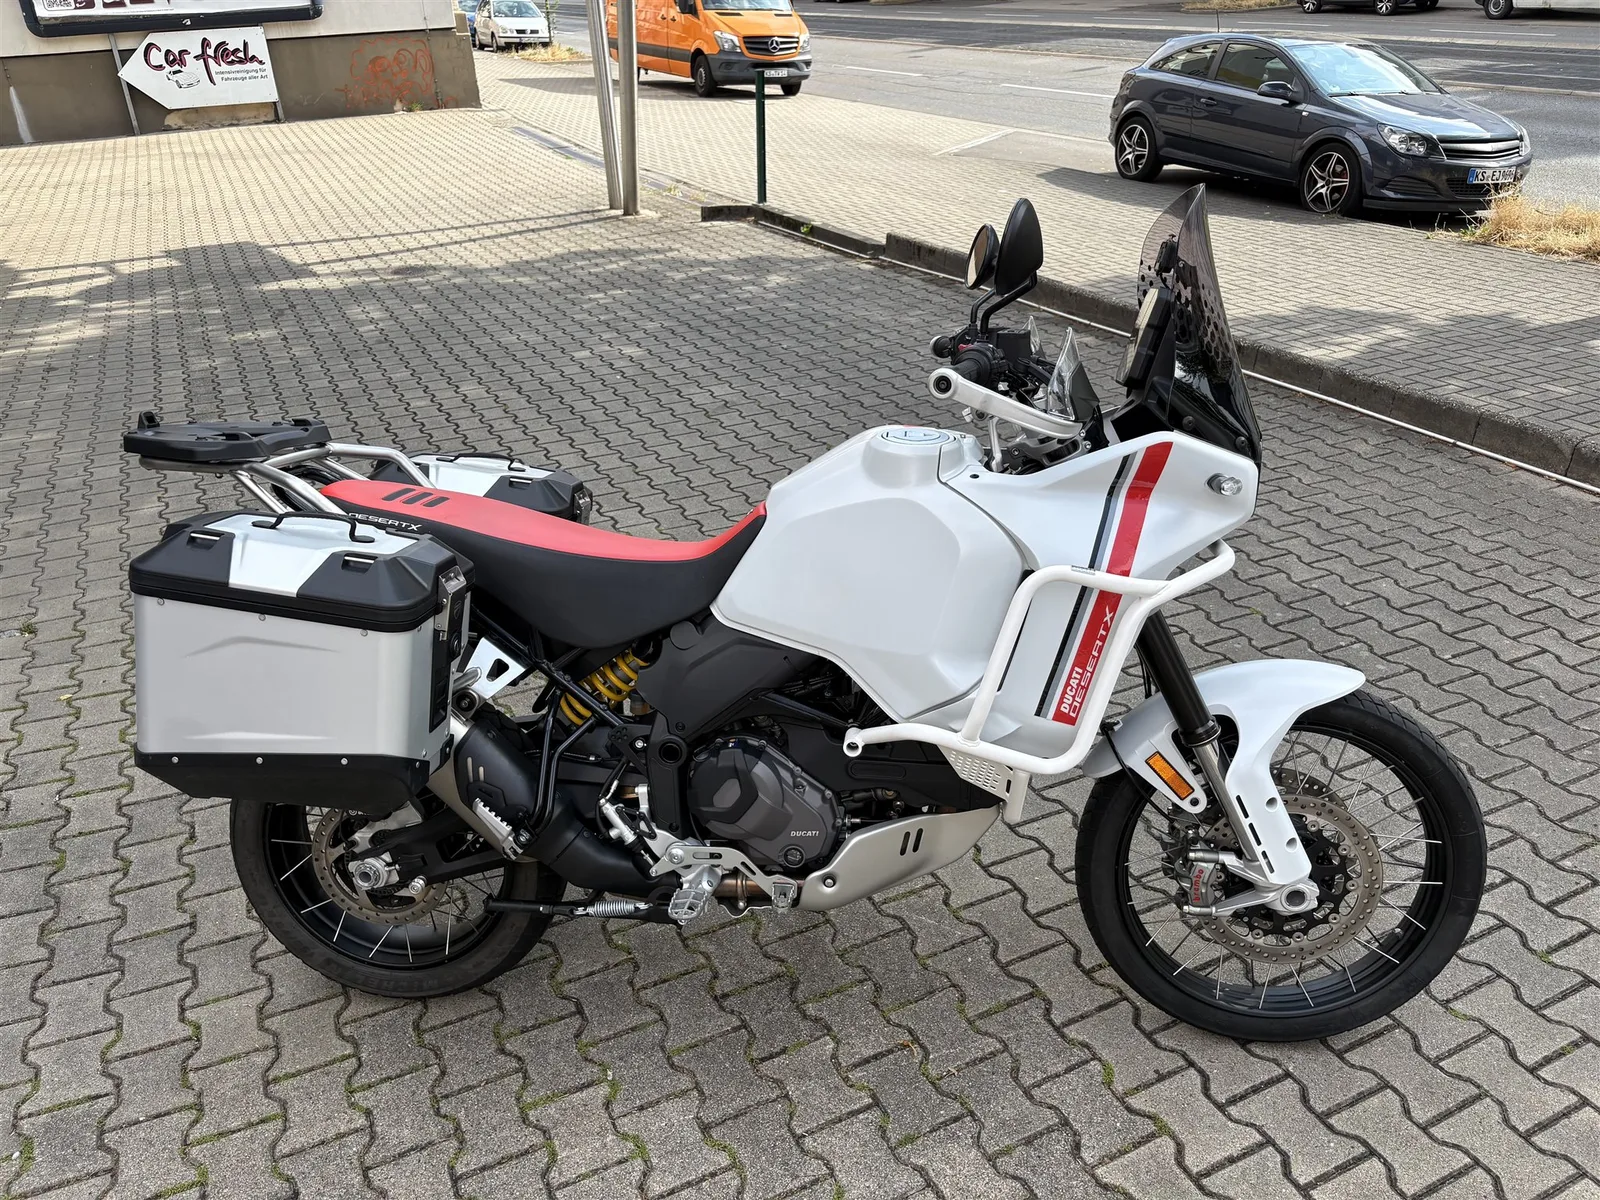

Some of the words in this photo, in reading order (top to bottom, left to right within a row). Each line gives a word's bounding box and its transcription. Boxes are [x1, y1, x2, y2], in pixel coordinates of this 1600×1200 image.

[143, 42, 191, 71] Car
[193, 37, 265, 86] fresh
[1474, 170, 1486, 182] KS
[1069, 605, 1114, 718] DESERTX
[1060, 666, 1083, 714] DUCATI
[1192, 869, 1204, 903] brembo
